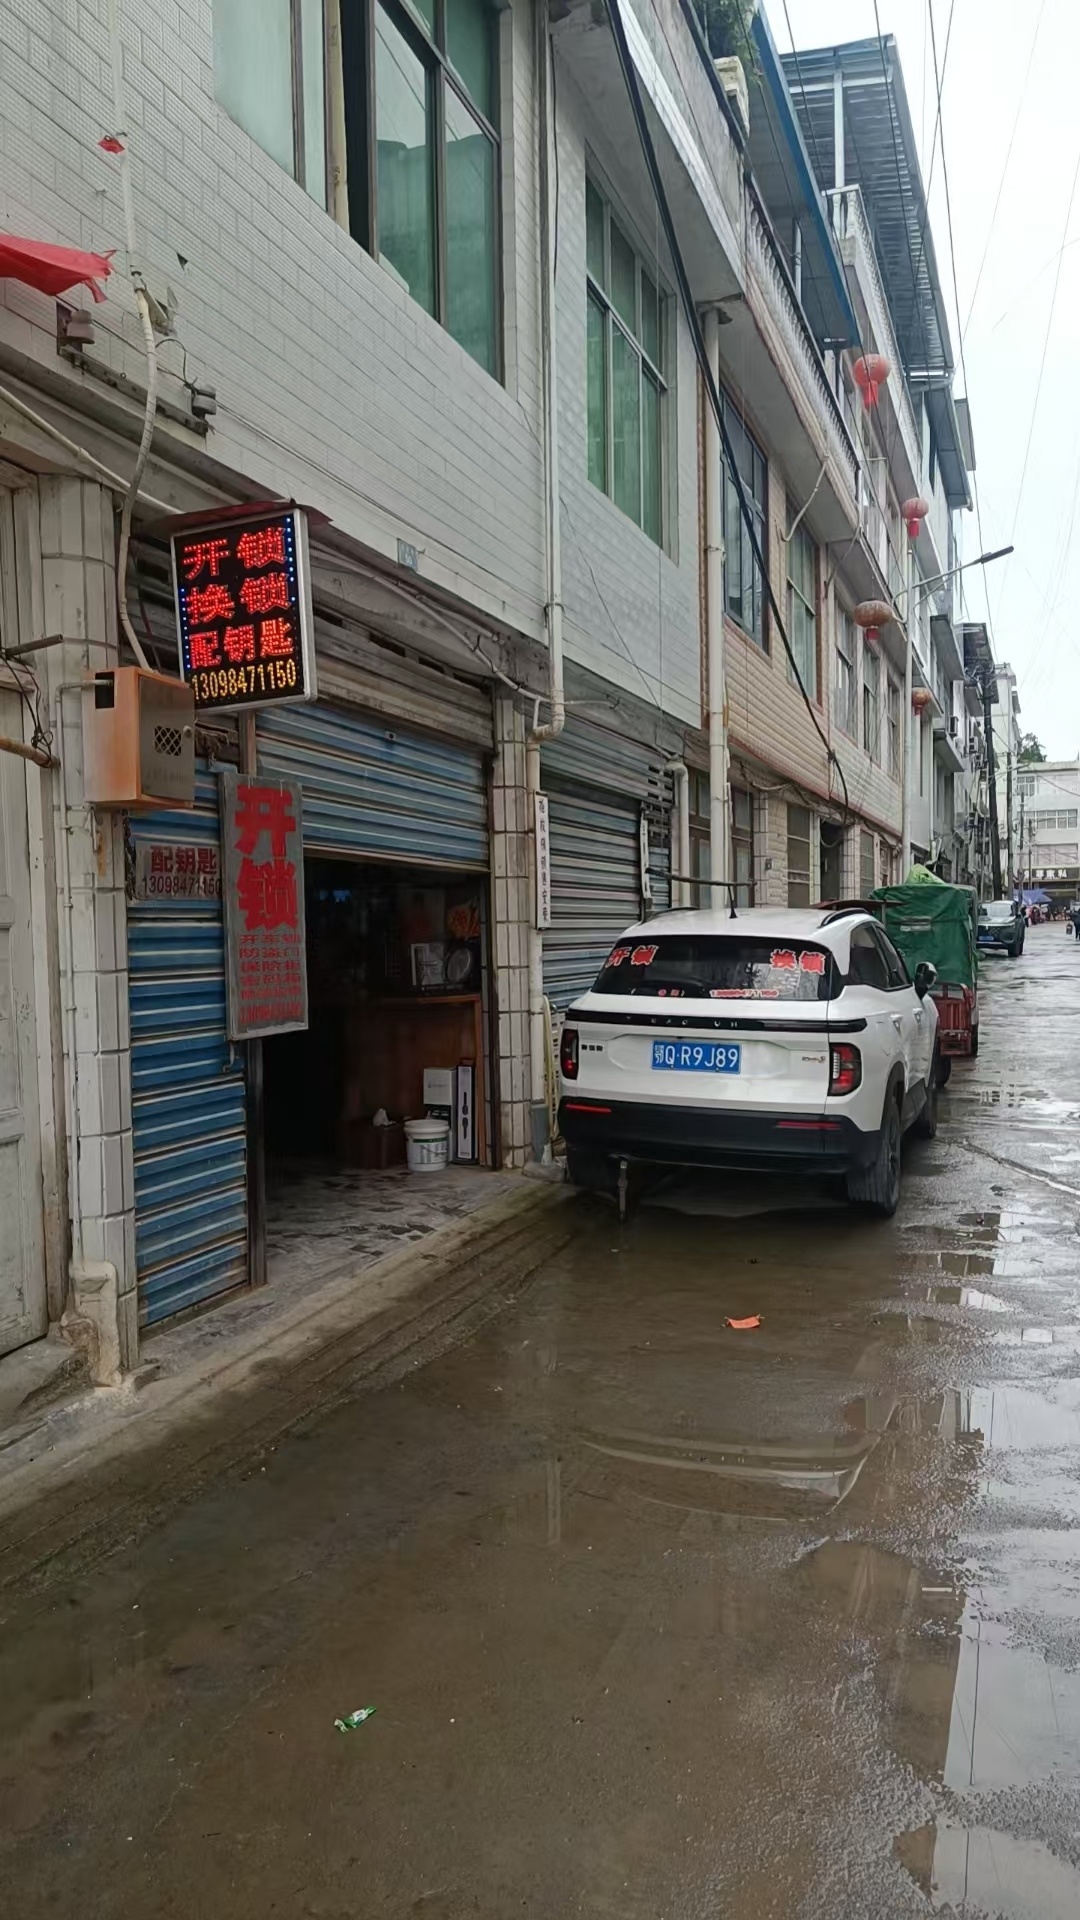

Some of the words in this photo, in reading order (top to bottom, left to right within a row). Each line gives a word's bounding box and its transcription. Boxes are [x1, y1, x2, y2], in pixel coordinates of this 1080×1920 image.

[183, 527, 288, 581] 开锁
[186, 572, 291, 626] 换锁
[189, 618, 294, 670] 配钥匙
[192, 659, 297, 701] 13098471150
[151, 846, 218, 875] 配钥匙
[234, 784, 298, 930] 开锁
